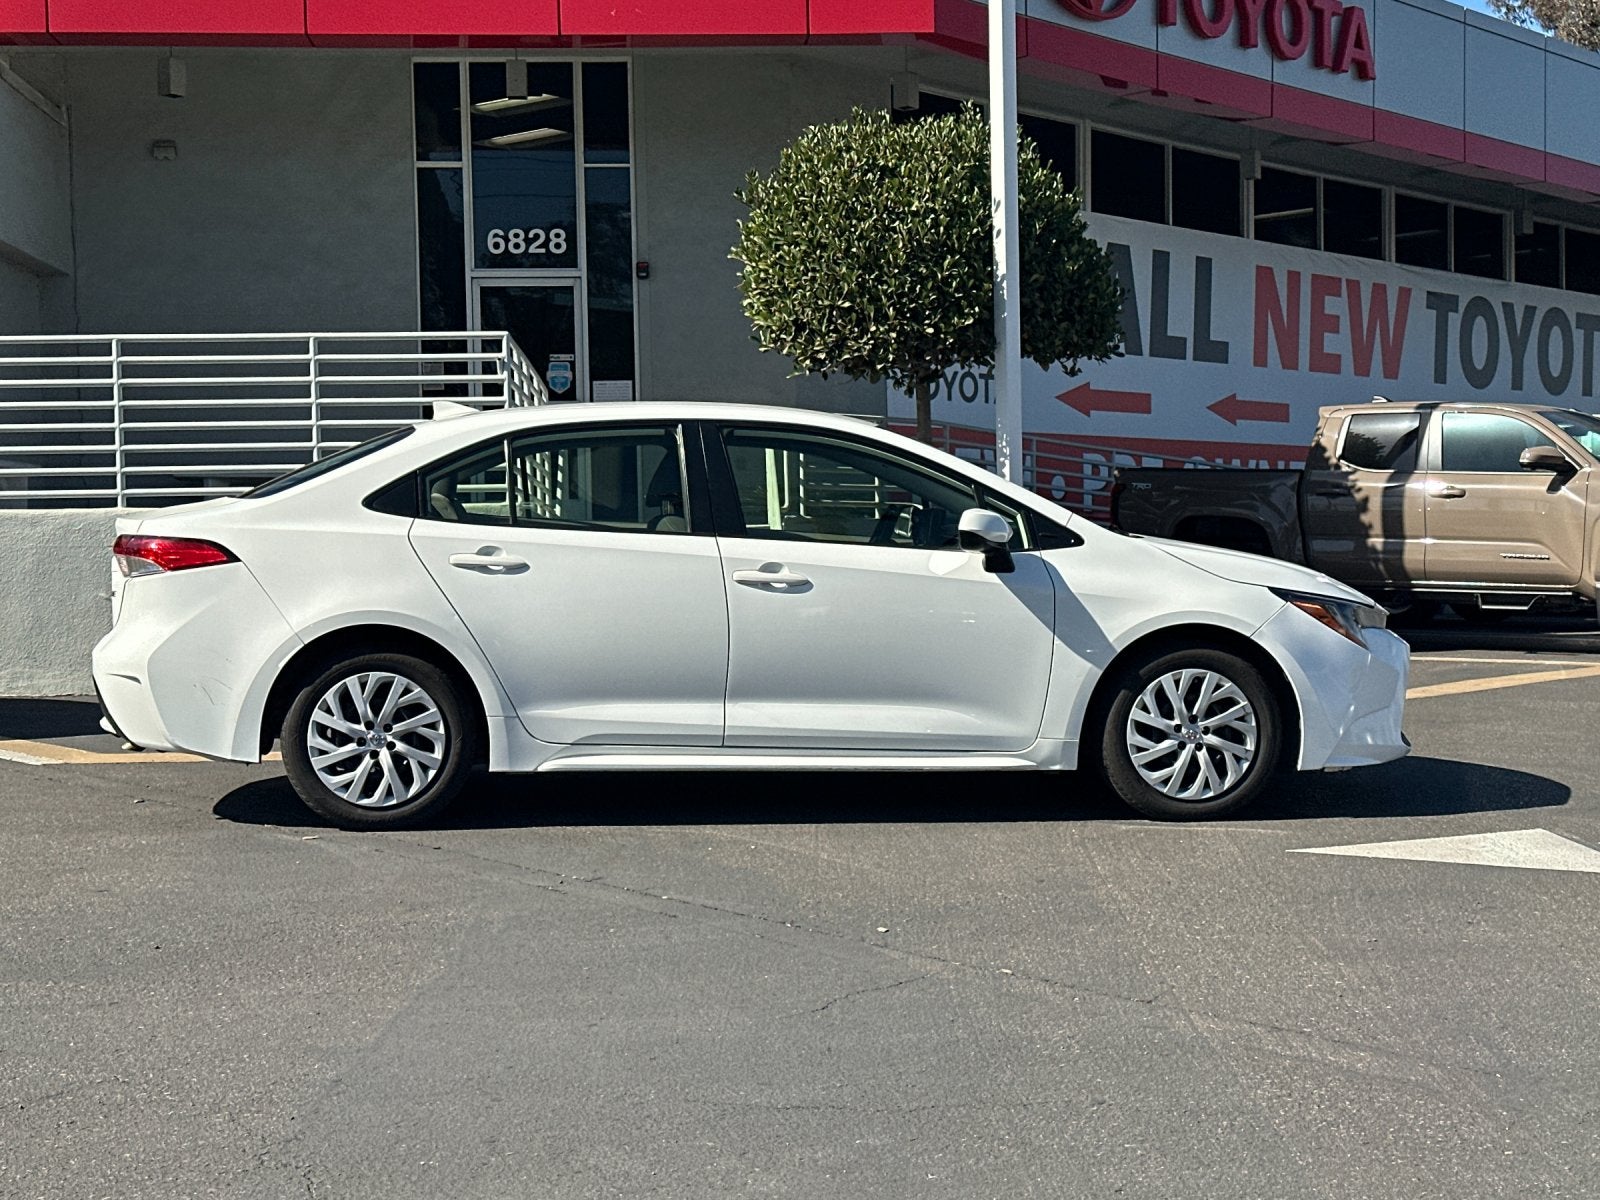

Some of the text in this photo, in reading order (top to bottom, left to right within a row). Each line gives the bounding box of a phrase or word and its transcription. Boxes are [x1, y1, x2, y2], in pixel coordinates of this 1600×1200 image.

[487, 228, 567, 254] 6828
[1253, 264, 1413, 380] NEW
[1426, 290, 1600, 398] TOYOT
